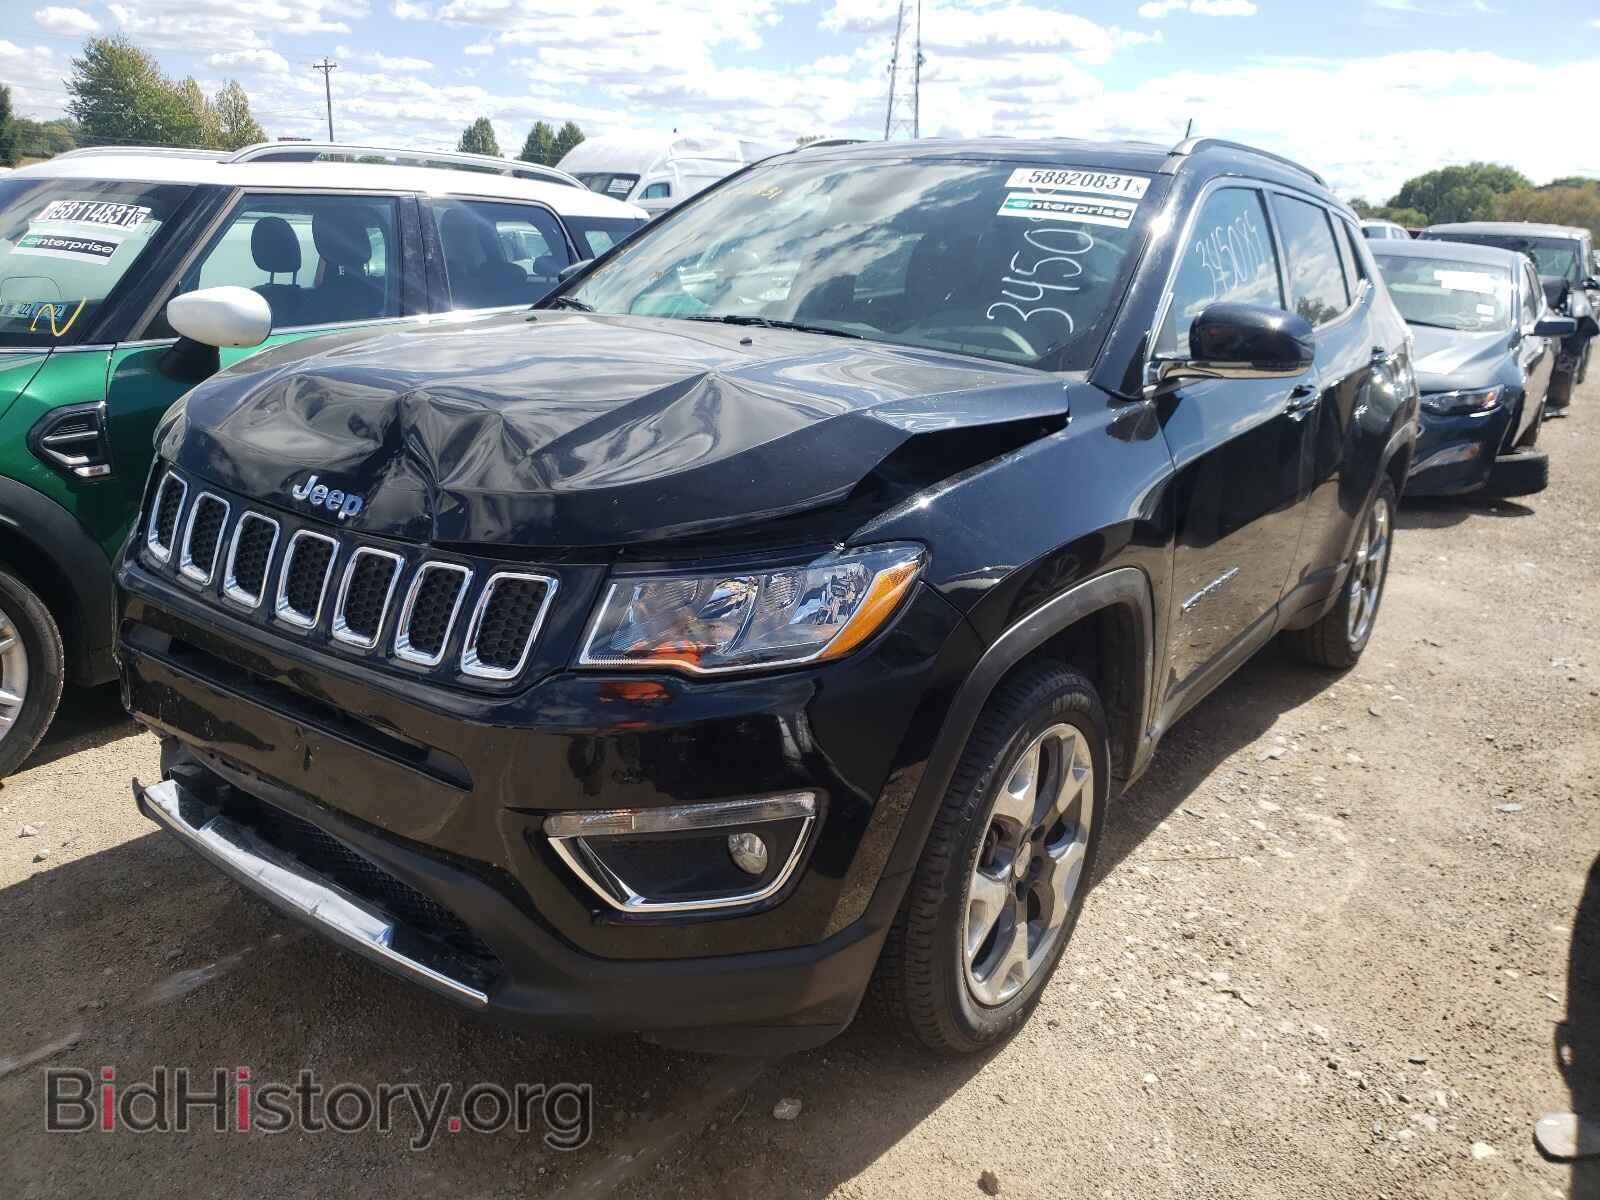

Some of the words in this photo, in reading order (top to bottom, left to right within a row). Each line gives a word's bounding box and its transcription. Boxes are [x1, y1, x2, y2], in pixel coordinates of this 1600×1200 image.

[1014, 200, 1131, 219] enterprise
[26, 235, 115, 254] enterprise
[987, 187, 1093, 333] 3450
[292, 475, 363, 520] Jeep
